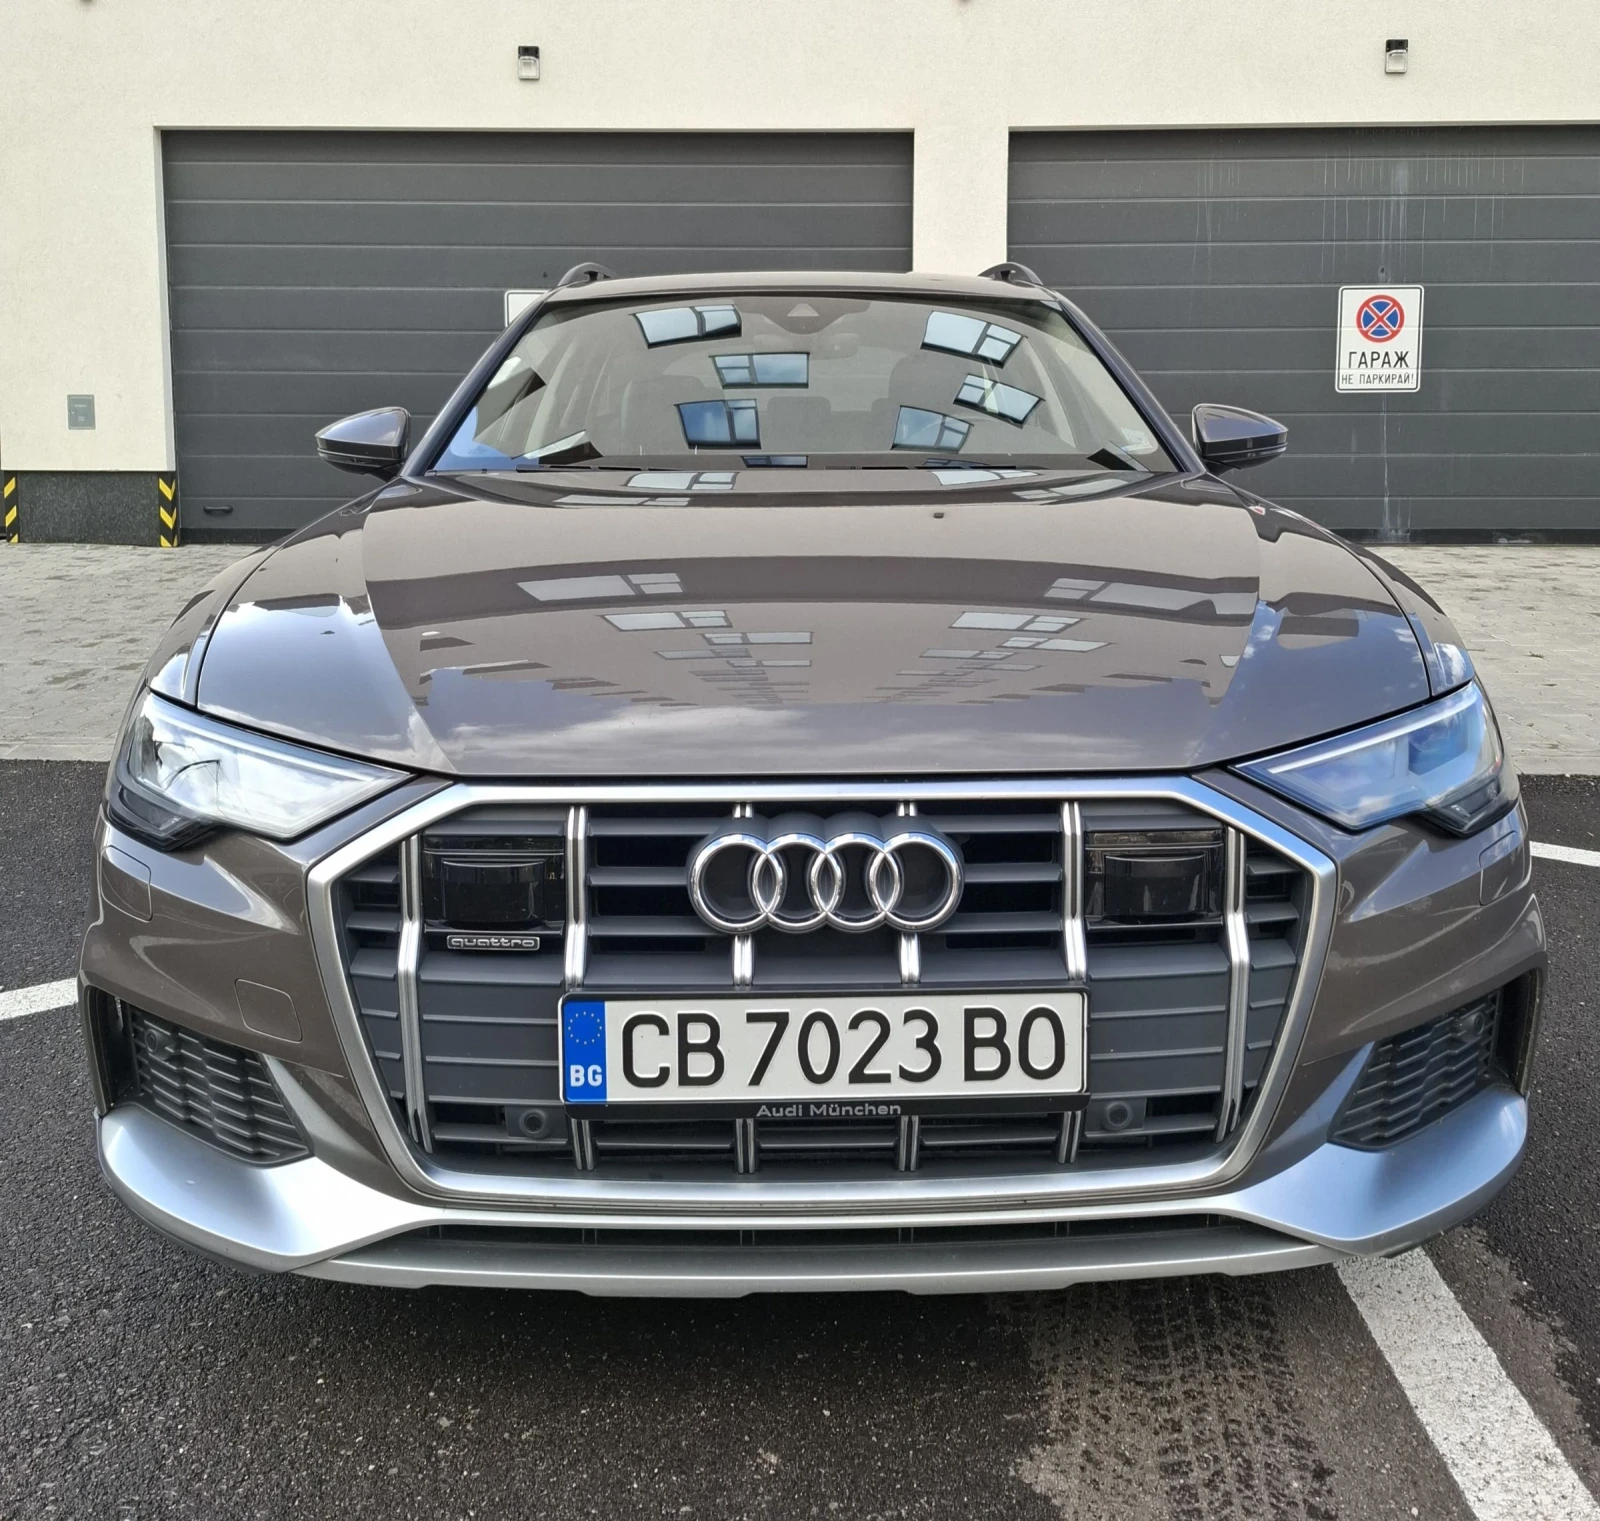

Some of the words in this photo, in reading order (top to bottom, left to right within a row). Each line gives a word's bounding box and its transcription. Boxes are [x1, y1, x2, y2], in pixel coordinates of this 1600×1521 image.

[1348, 351, 1409, 368] ГАРАЖ
[1341, 374, 1354, 385] НЕ
[1359, 372, 1414, 385] ПАРКИРАЙ!
[451, 937, 535, 948] quattro
[622, 1012, 725, 1089] CB
[745, 1009, 942, 1087] 7023
[963, 1006, 1066, 1082] BO
[569, 1064, 603, 1088] BG
[755, 1104, 803, 1117] Audi
[809, 1103, 902, 1117] München
